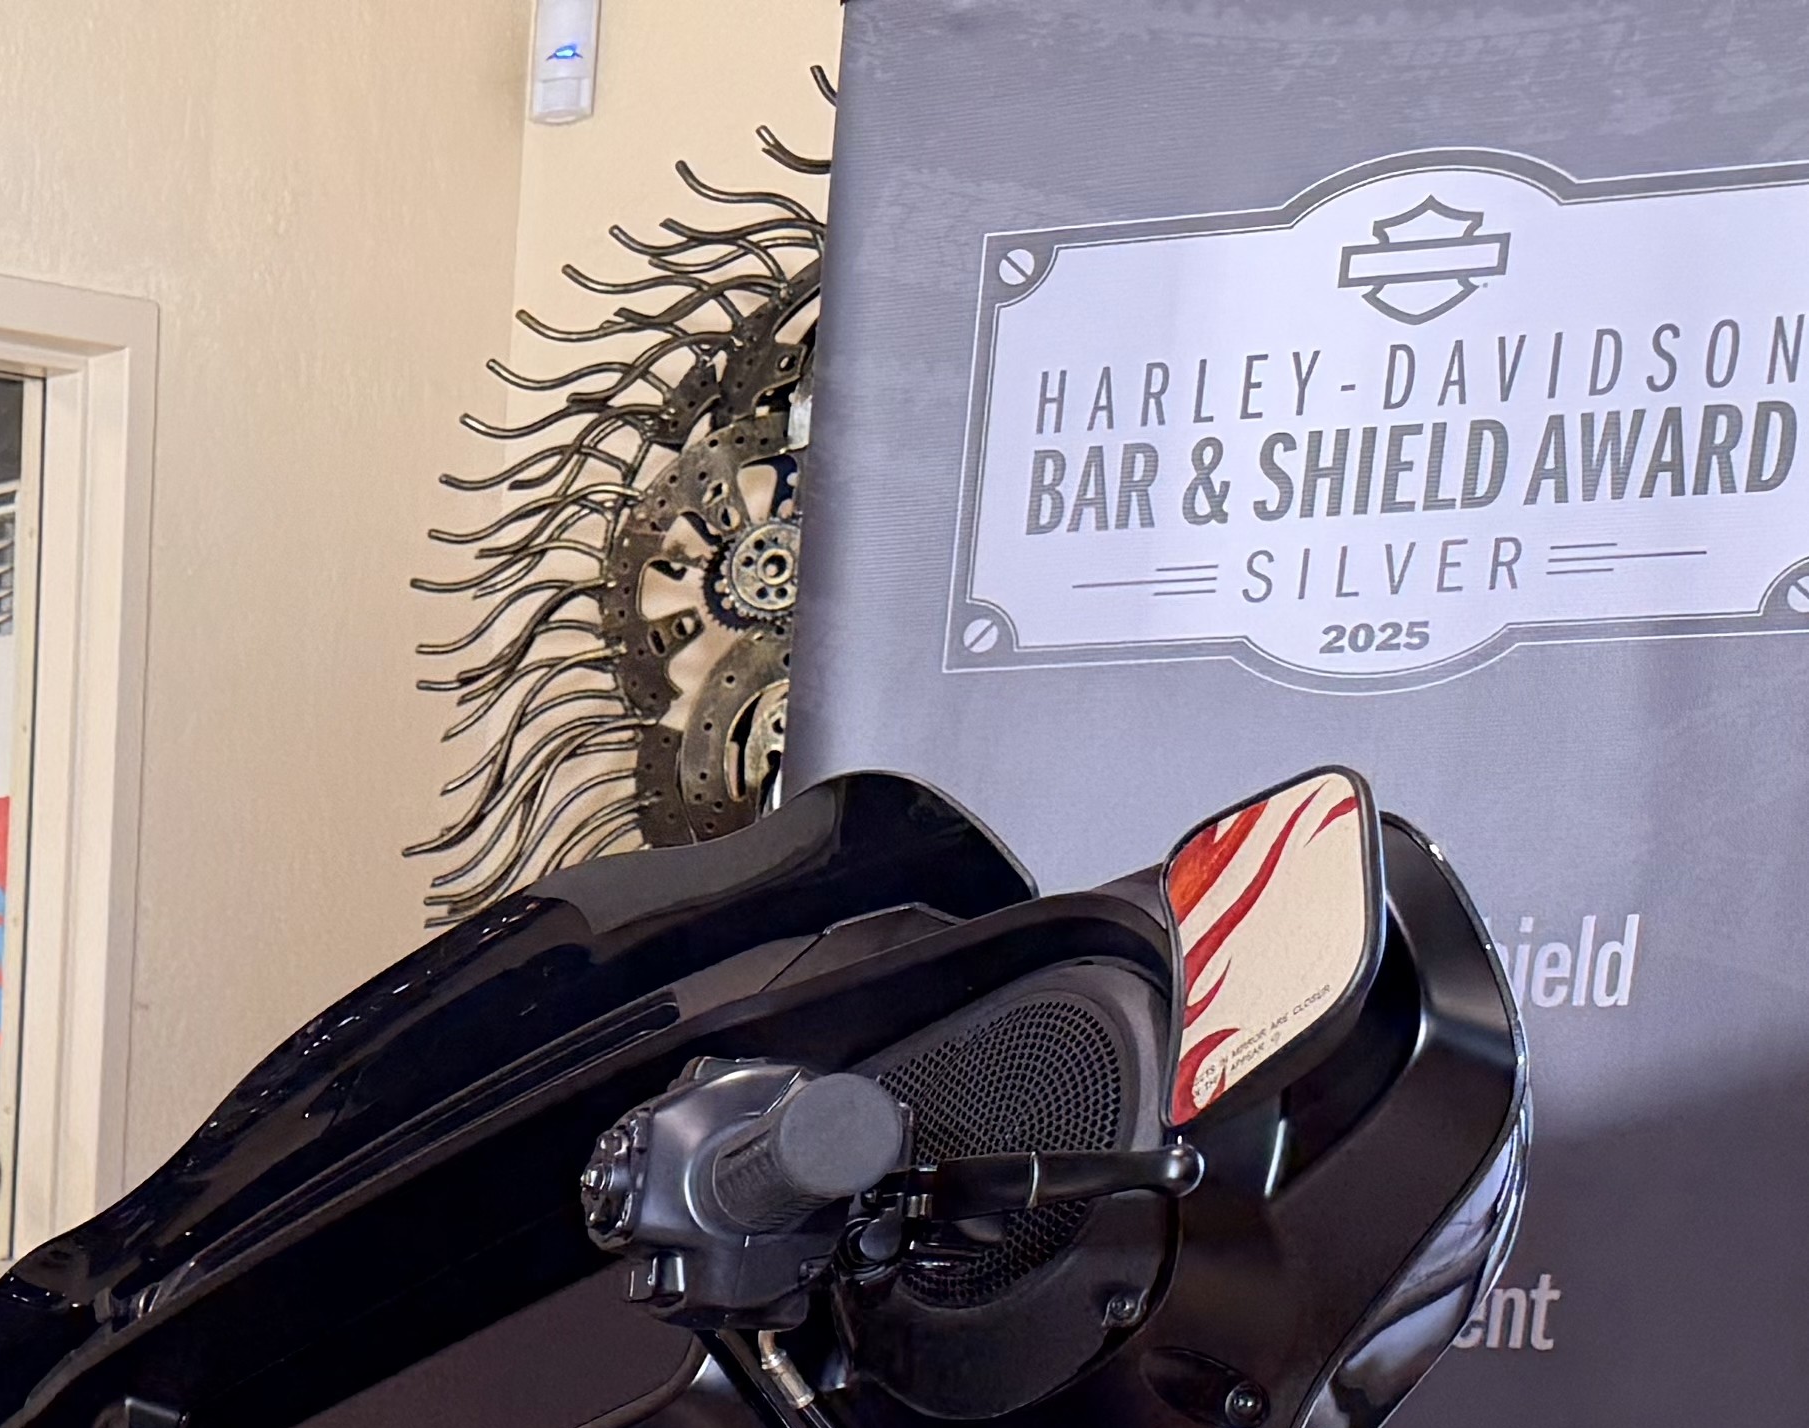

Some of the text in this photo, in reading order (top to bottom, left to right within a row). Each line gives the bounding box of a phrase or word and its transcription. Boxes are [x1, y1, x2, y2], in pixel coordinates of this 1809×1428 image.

[1025, 400, 1798, 536] BAR & SHIELD AWARD
[1241, 535, 1523, 604] SILVER
[1318, 619, 1431, 656] 2025
